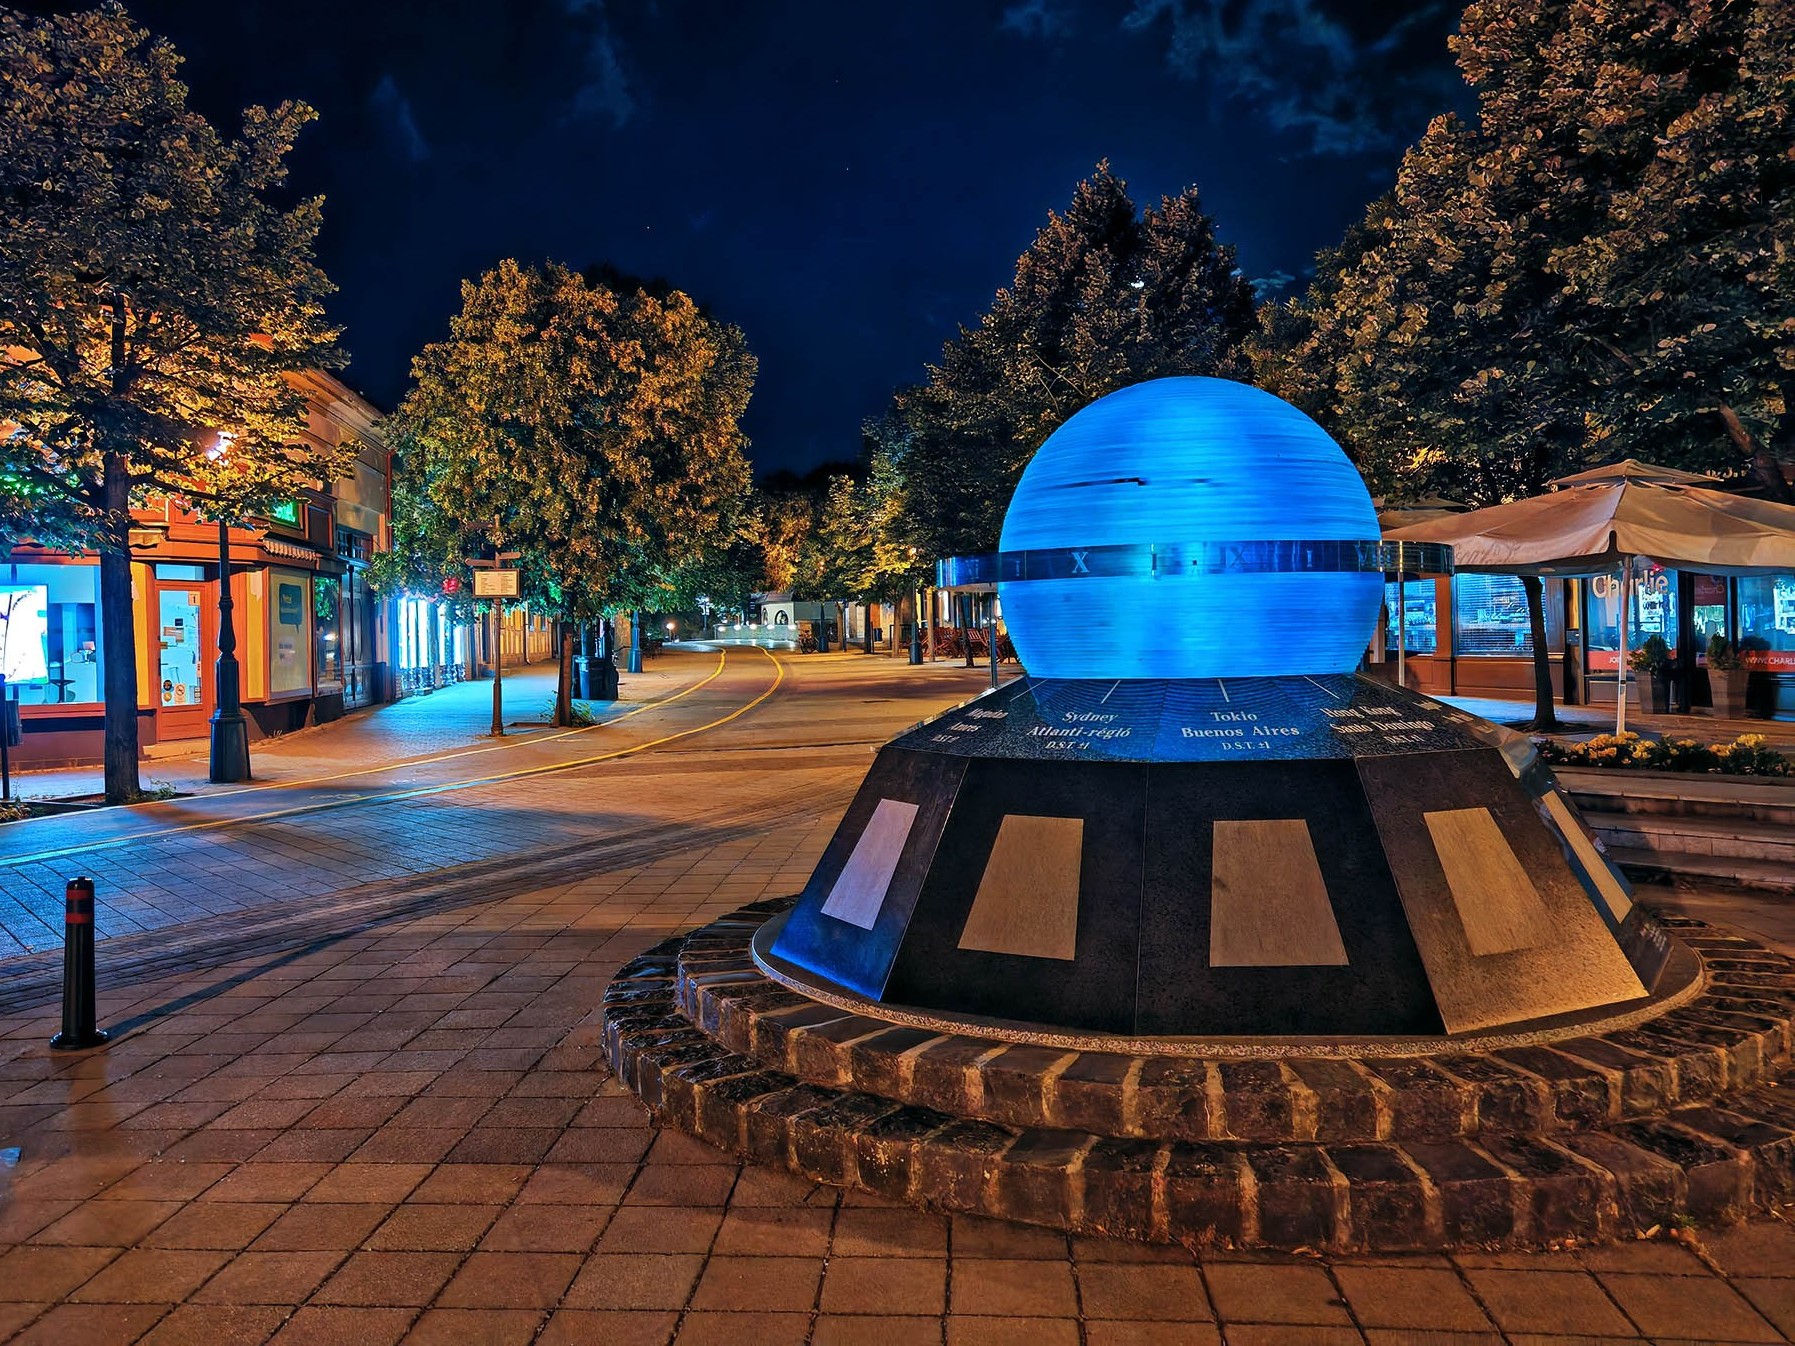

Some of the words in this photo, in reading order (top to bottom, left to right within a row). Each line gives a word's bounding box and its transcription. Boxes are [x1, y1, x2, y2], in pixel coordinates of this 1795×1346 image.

[1071, 551, 1090, 573] X
[1062, 711, 1119, 724] Sydney
[1210, 711, 1258, 722] Tokio
[1027, 725, 1131, 739] Atlanti-régió
[1181, 727, 1244, 738] Buenos
[1252, 725, 1300, 736] Aires
[1372, 720, 1435, 731] Domingo
[1221, 742, 1256, 750] D.S.T.
